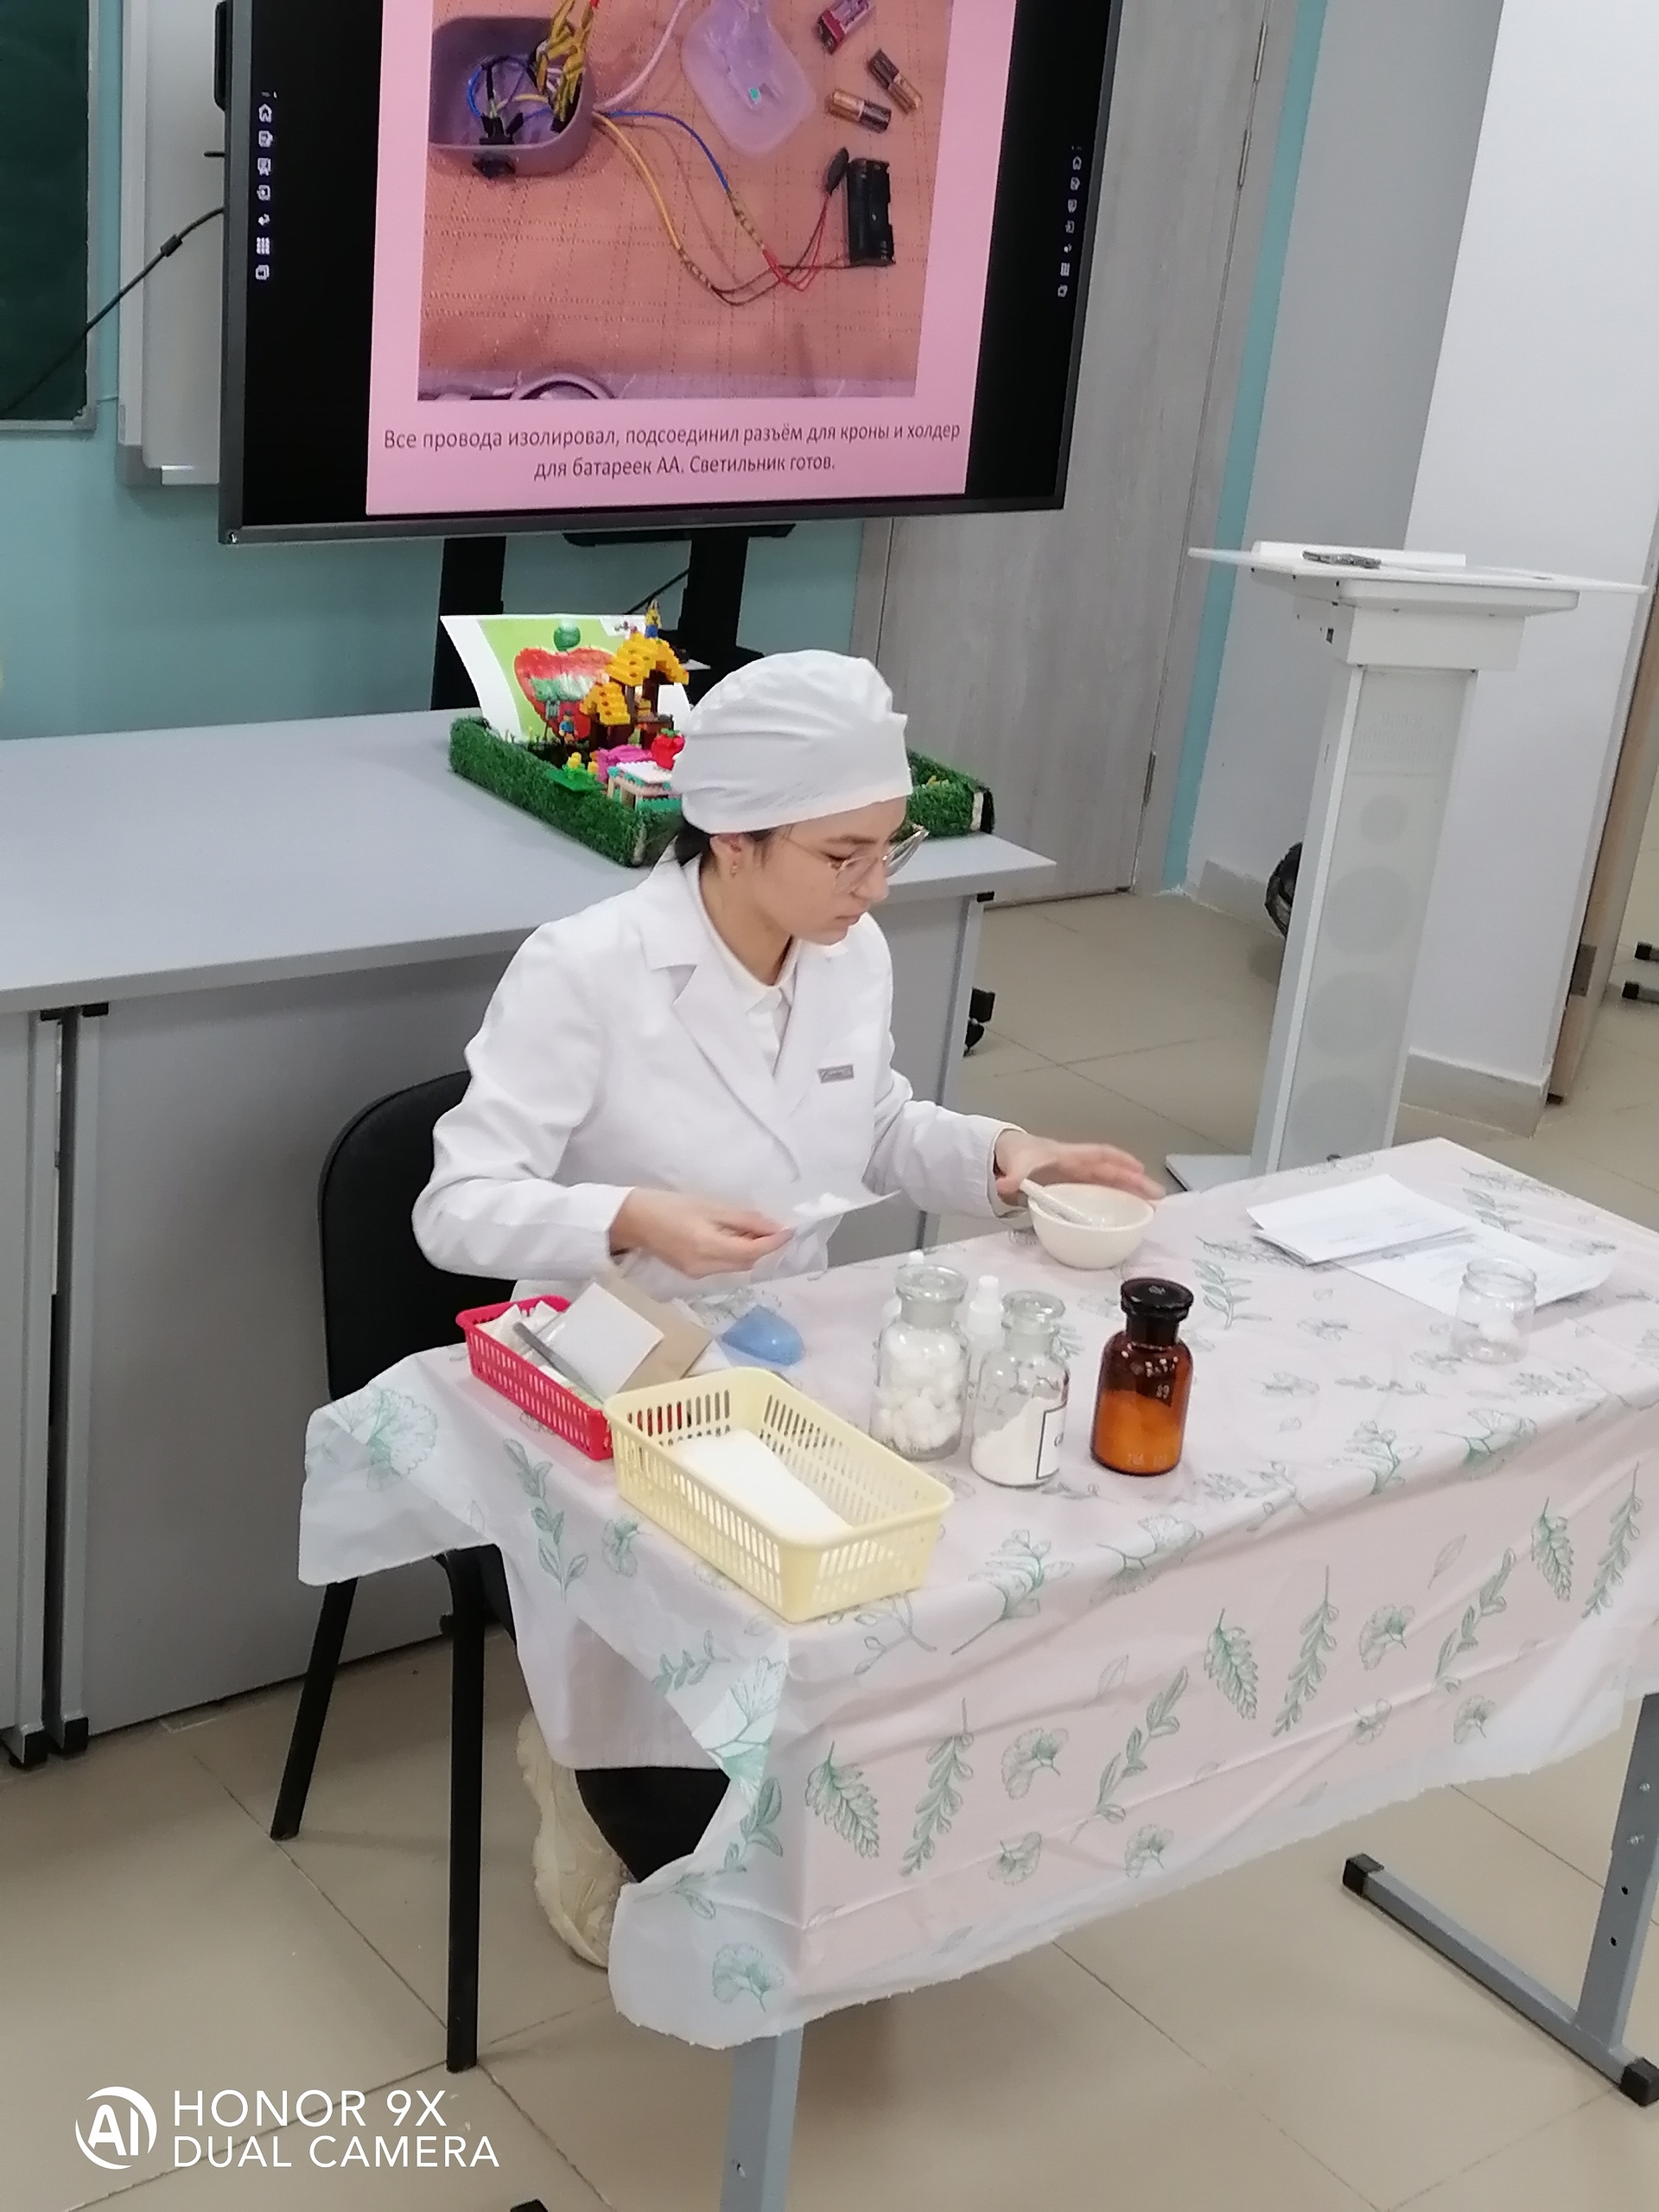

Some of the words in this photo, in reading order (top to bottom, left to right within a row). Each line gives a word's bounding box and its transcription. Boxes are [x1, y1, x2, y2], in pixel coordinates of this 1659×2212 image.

[385, 429, 416, 448] Все
[423, 432, 502, 452] провода
[508, 430, 620, 448] изолировал,
[626, 428, 739, 448] подсоединил
[743, 423, 803, 446] разъём
[806, 426, 836, 444] для
[841, 424, 889, 443] кроны
[893, 425, 903, 437] и
[907, 423, 961, 442] холдер
[534, 463, 567, 481] для
[573, 456, 652, 479] батареек
[690, 454, 785, 474] Светильник
[790, 455, 835, 471] готов.
